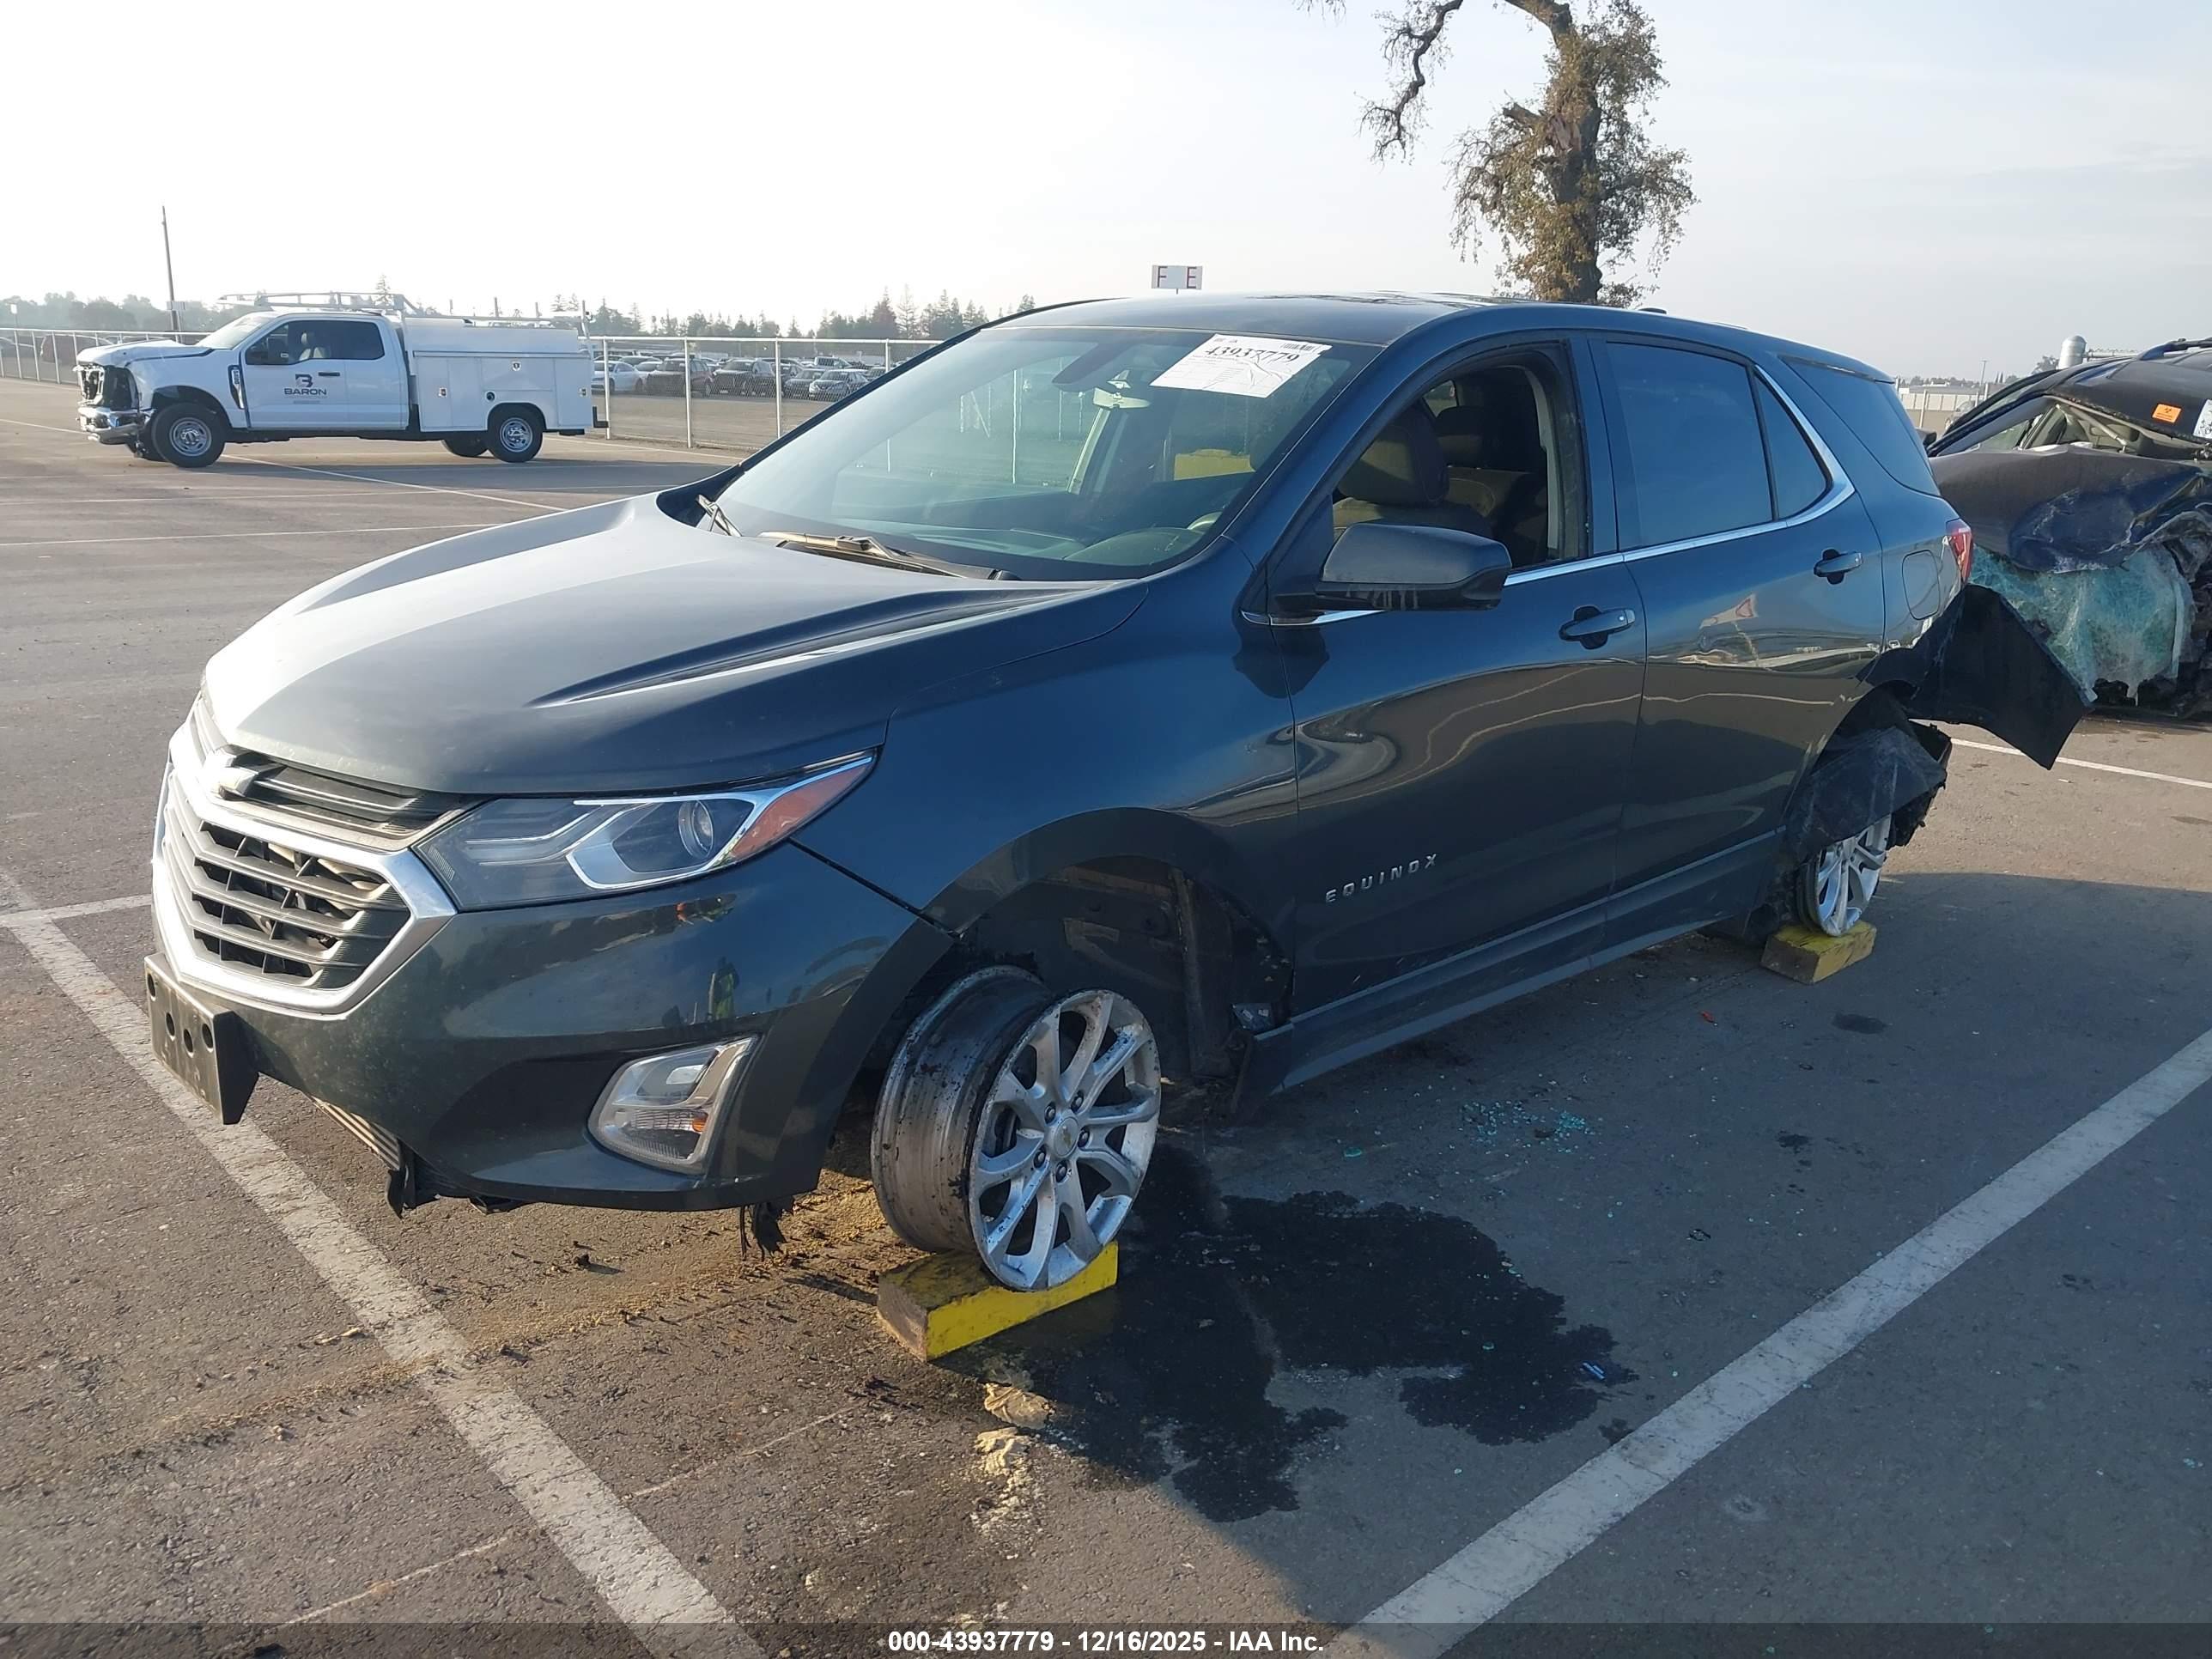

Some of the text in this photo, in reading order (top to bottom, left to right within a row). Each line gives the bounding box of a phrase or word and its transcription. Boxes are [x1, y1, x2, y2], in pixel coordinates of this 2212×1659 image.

[1157, 265, 1197, 289] F E
[1205, 345, 1300, 363] 43937779
[1325, 853, 1437, 902] EQUINOX
